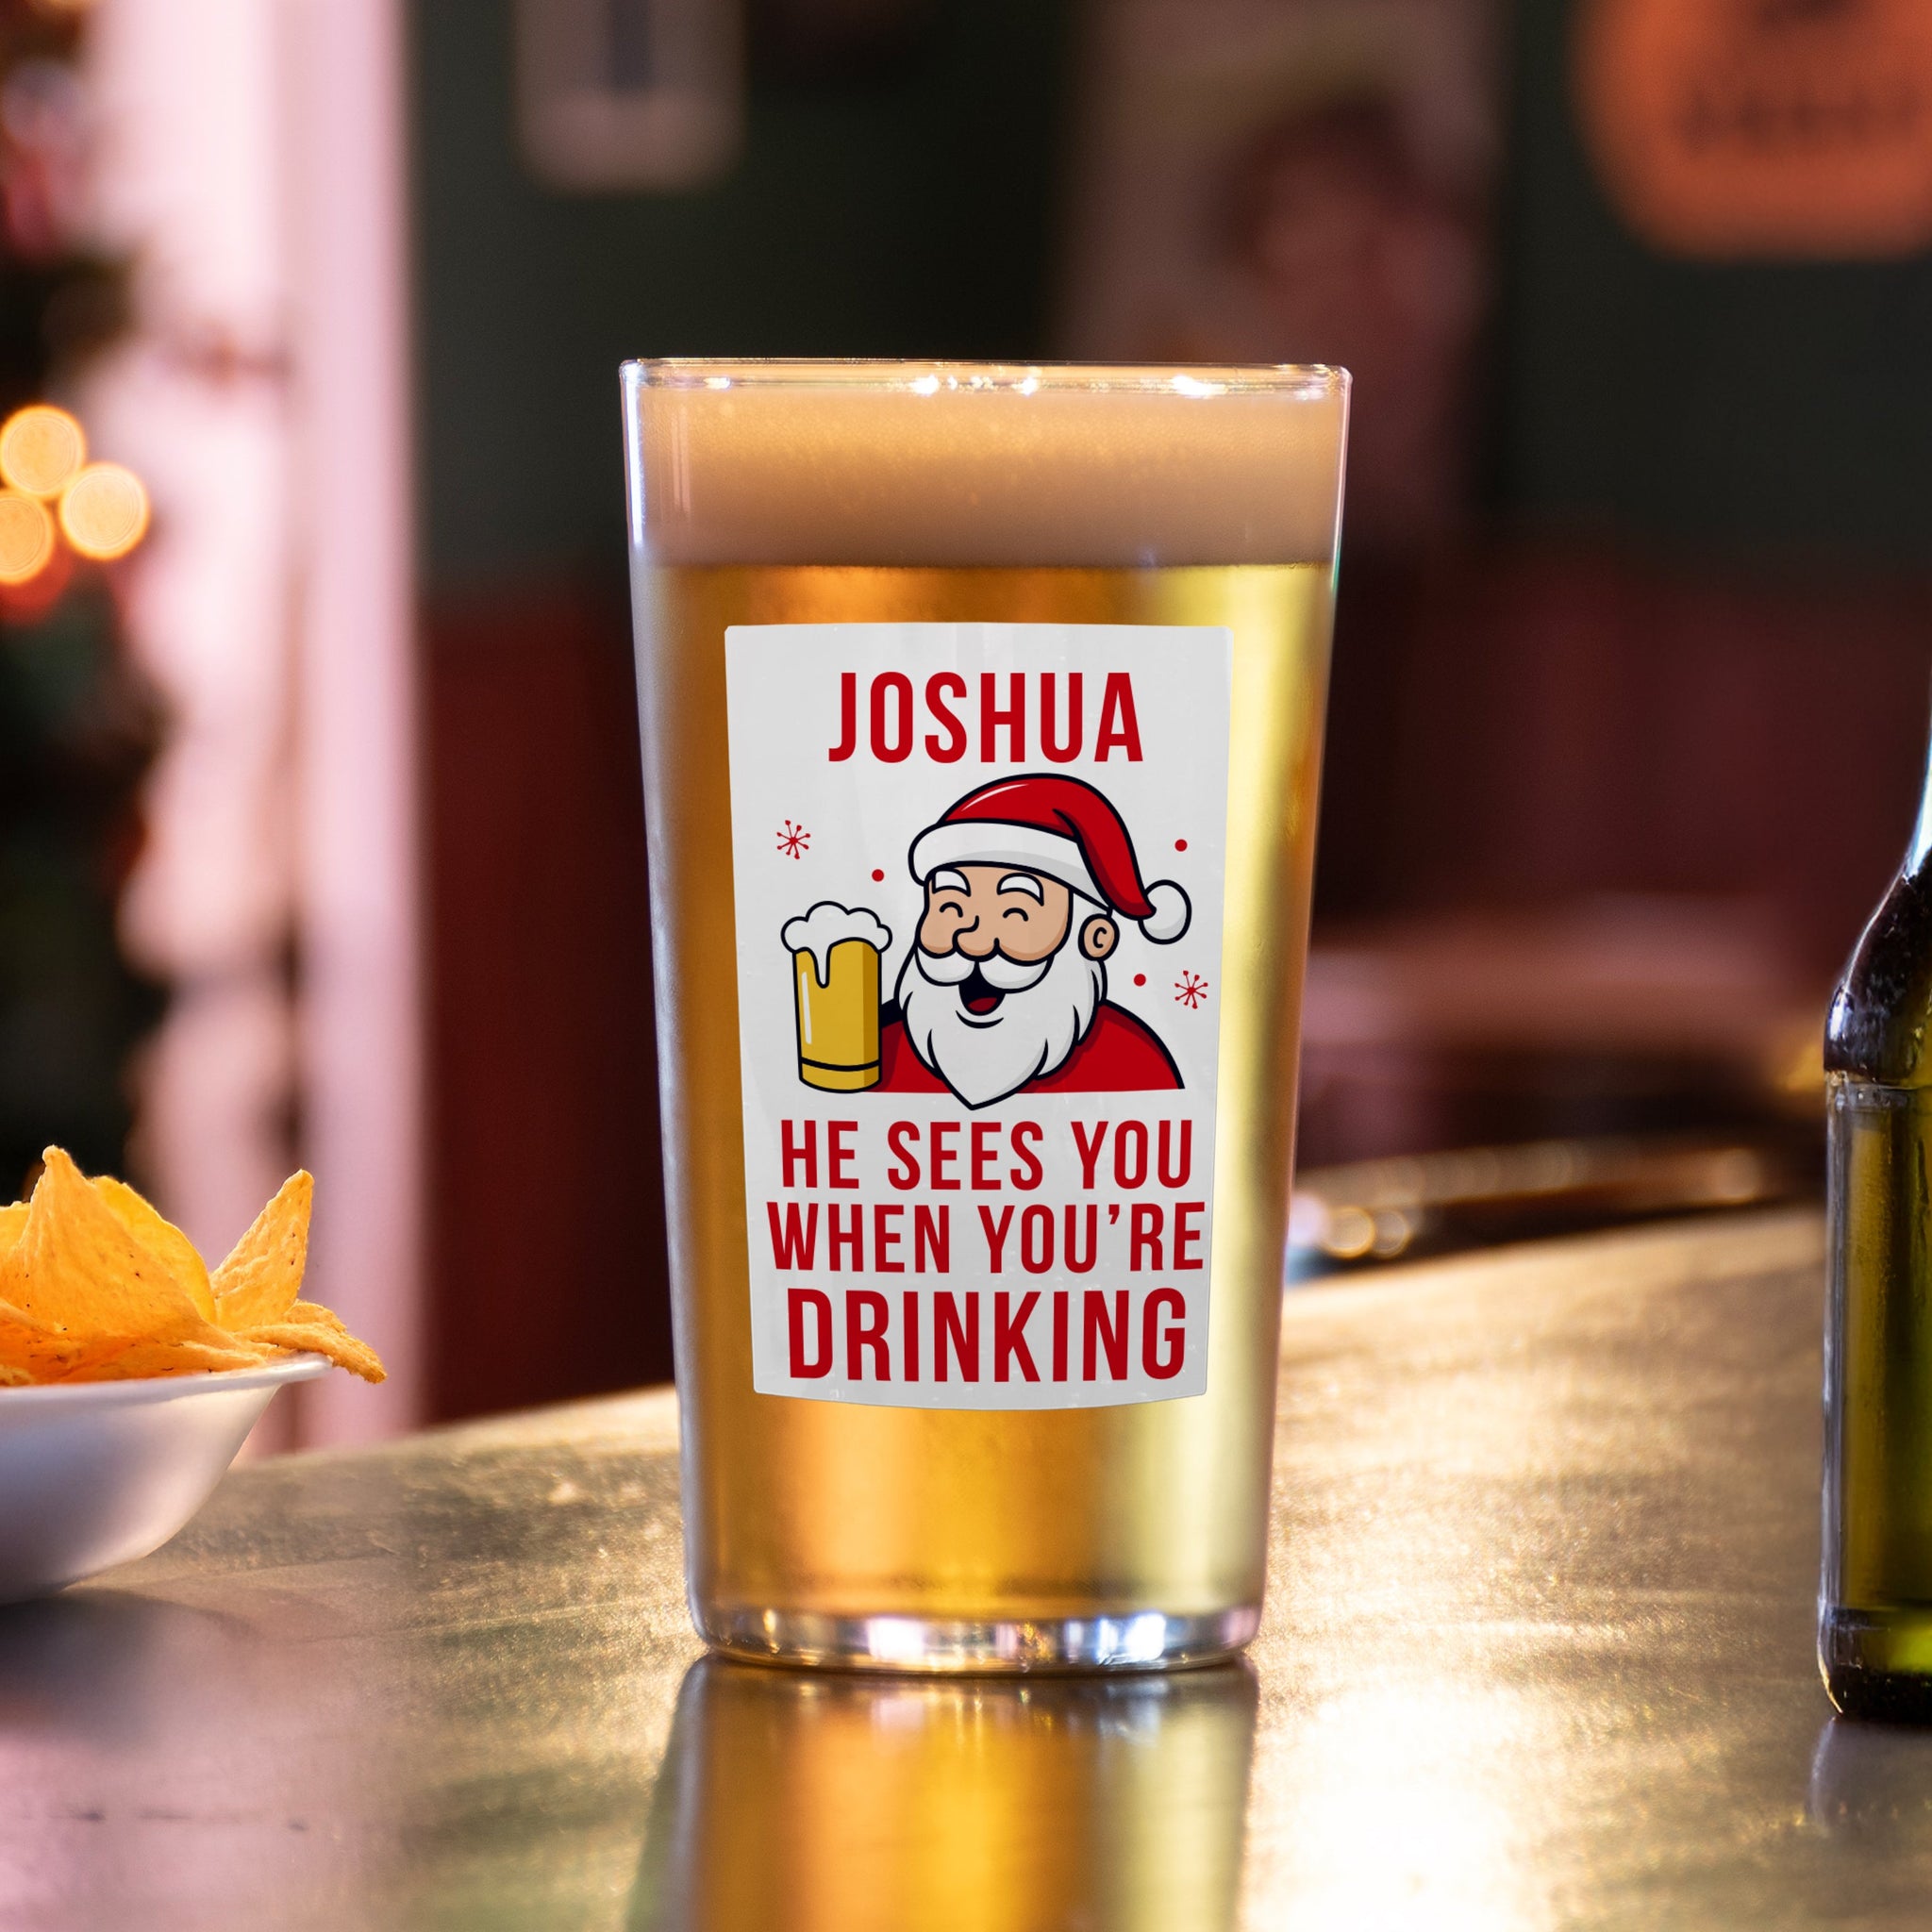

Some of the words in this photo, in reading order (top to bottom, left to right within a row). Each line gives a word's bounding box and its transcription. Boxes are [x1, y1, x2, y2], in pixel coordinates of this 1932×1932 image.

[828, 671, 1143, 763] JOSHUA
[780, 1119, 859, 1190] HE
[887, 1120, 1043, 1191] SEES
[1070, 1119, 1192, 1190] YOU
[766, 1201, 951, 1274] WHEN
[976, 1201, 1206, 1274] YOU’RE
[787, 1287, 1186, 1383] DRINKING
